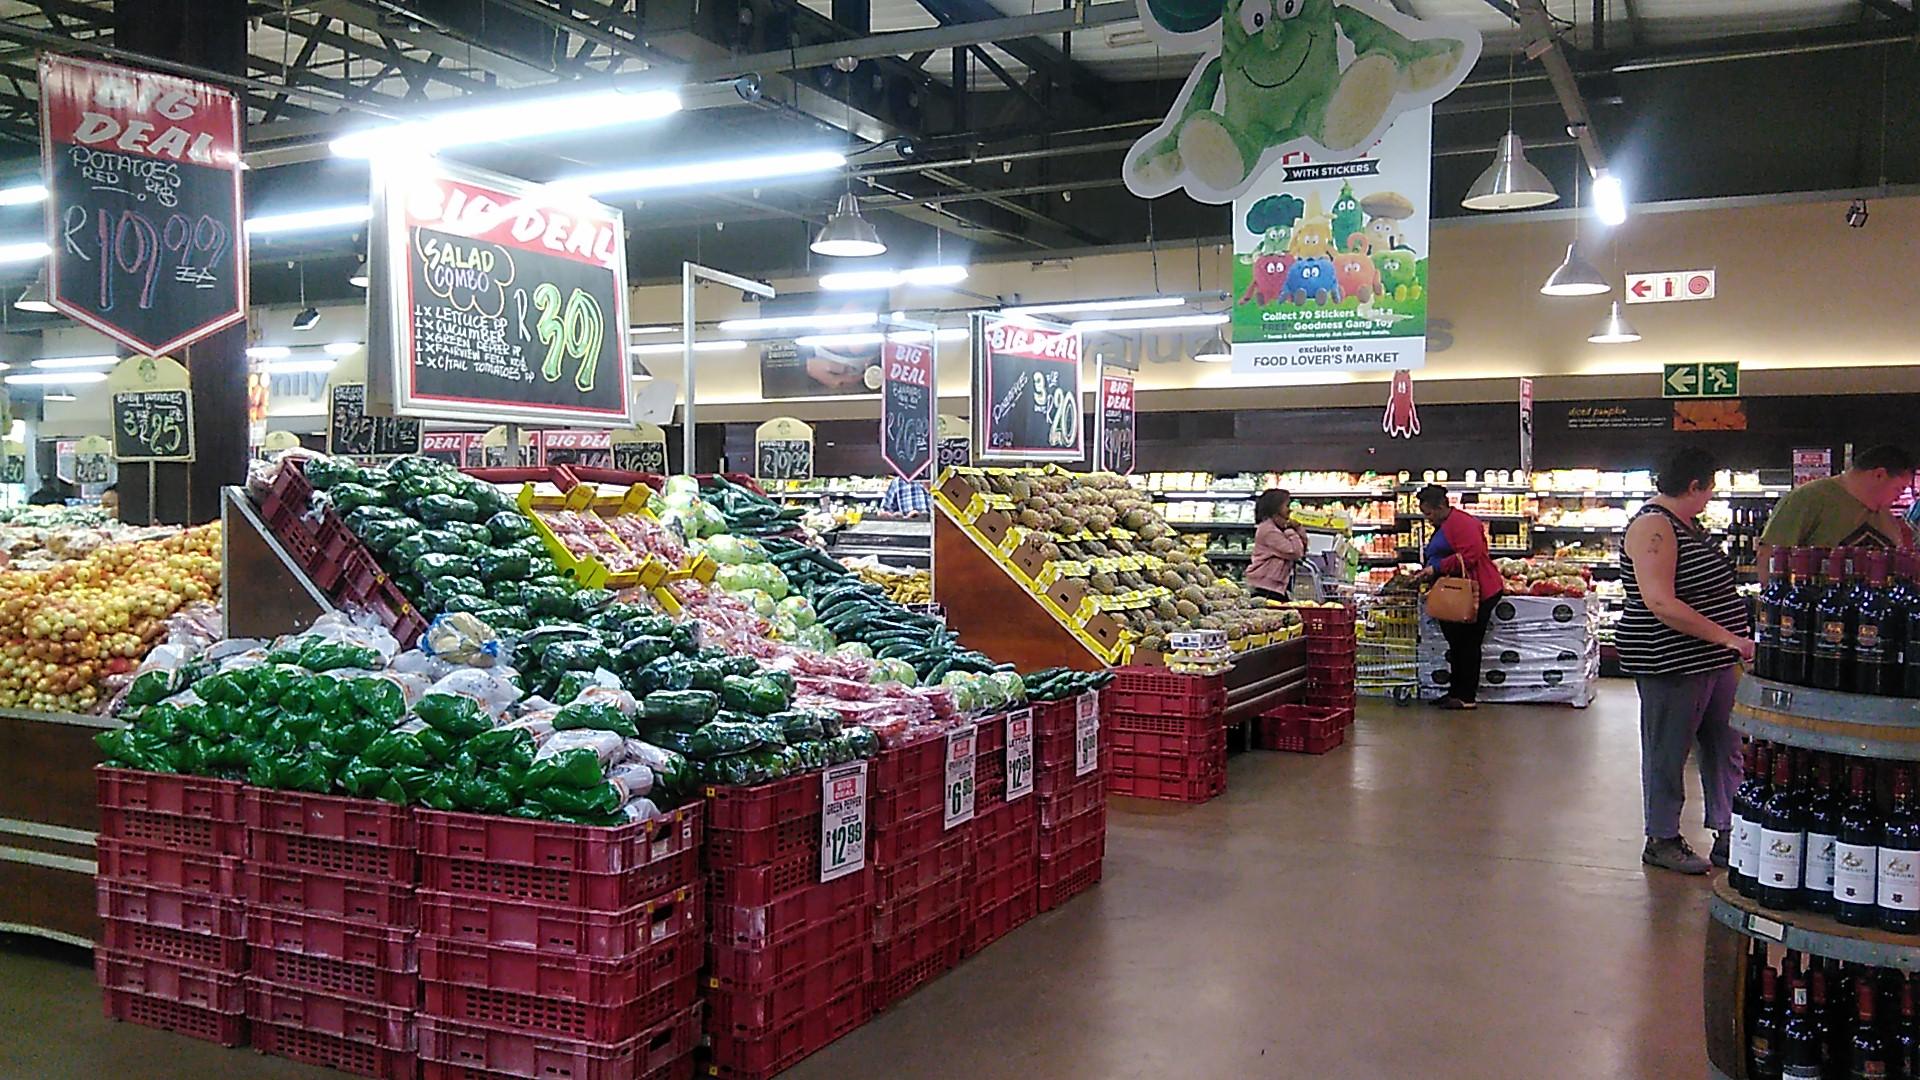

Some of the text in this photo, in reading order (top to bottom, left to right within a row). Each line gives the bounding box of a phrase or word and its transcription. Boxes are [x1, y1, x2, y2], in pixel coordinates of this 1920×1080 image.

[73, 112, 214, 164] DEAL
[68, 146, 181, 188] POTATOES
[82, 167, 119, 184] RED
[1292, 163, 1370, 178] WITH STICKERS
[511, 205, 618, 263] DEAL
[426, 238, 496, 273] SALAD
[433, 268, 490, 293] COMBO
[436, 306, 489, 328] LETTUCE
[1262, 310, 1297, 321] Collect
[1300, 310, 1313, 320] 70
[1314, 308, 1355, 319] Stickers
[436, 319, 508, 345] CUCUMBER
[1293, 321, 1343, 331] Goodness
[1345, 319, 1372, 330] Gang
[1375, 319, 1394, 329] Toy
[435, 332, 471, 349] GREEN
[990, 327, 1077, 361] BIG DEAL
[1298, 344, 1353, 354] exclusive to
[436, 342, 480, 361] FAIRVIEW
[896, 344, 922, 364] BIG
[1253, 352, 1400, 367] FOOD LOVER'S MARKET
[473, 362, 521, 380] TOMATOES
[890, 363, 926, 385] DEAL
[1109, 381, 1128, 395] BIG
[1106, 394, 1131, 410] DEAL
[423, 436, 461, 449] DEAL
[546, 434, 577, 447] BIG
[580, 434, 610, 448] DEA
[1008, 733, 1032, 748] LETTUCE
